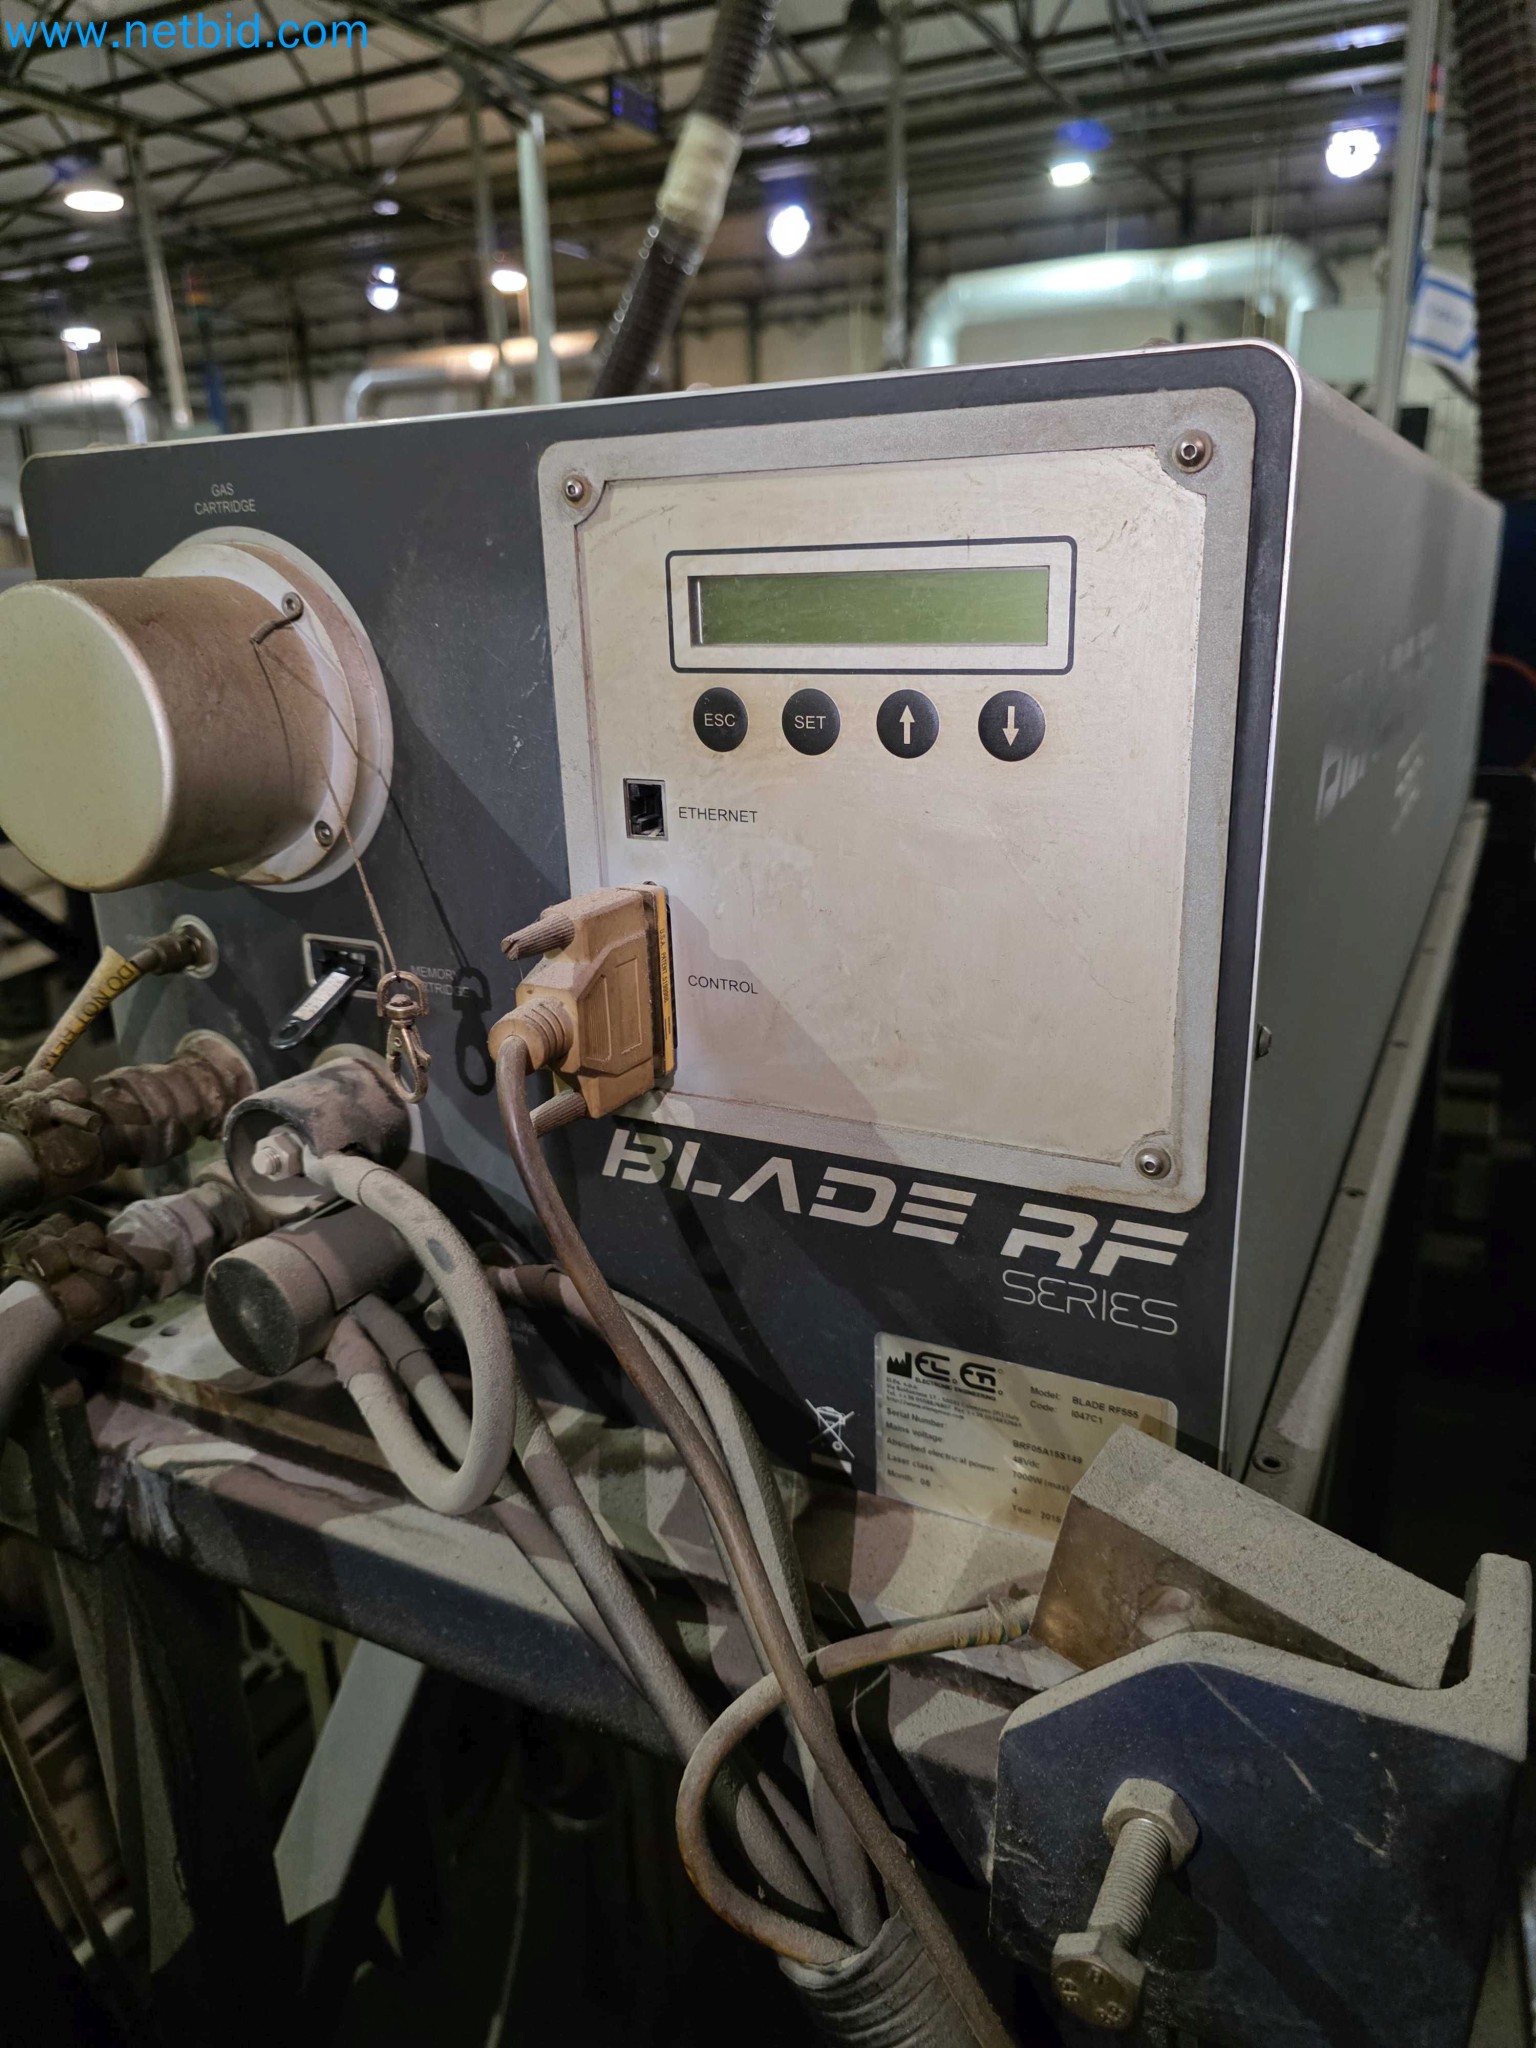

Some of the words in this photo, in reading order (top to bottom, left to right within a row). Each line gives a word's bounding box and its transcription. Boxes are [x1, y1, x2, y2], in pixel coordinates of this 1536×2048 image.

[211, 482, 235, 497] GAS
[194, 499, 257, 515] CARTRIDGE
[703, 712, 736, 728] ESC
[794, 715, 827, 730] SET
[678, 806, 758, 824] ETHERNET
[106, 964, 135, 992] DO
[687, 974, 759, 995] CONTROL
[78, 988, 112, 1025] NOT
[602, 1128, 977, 1246] BLADE
[1000, 1202, 1190, 1277] RF
[1002, 1270, 1180, 1337] SERIES
[1071, 1395, 1106, 1412] BLADE
